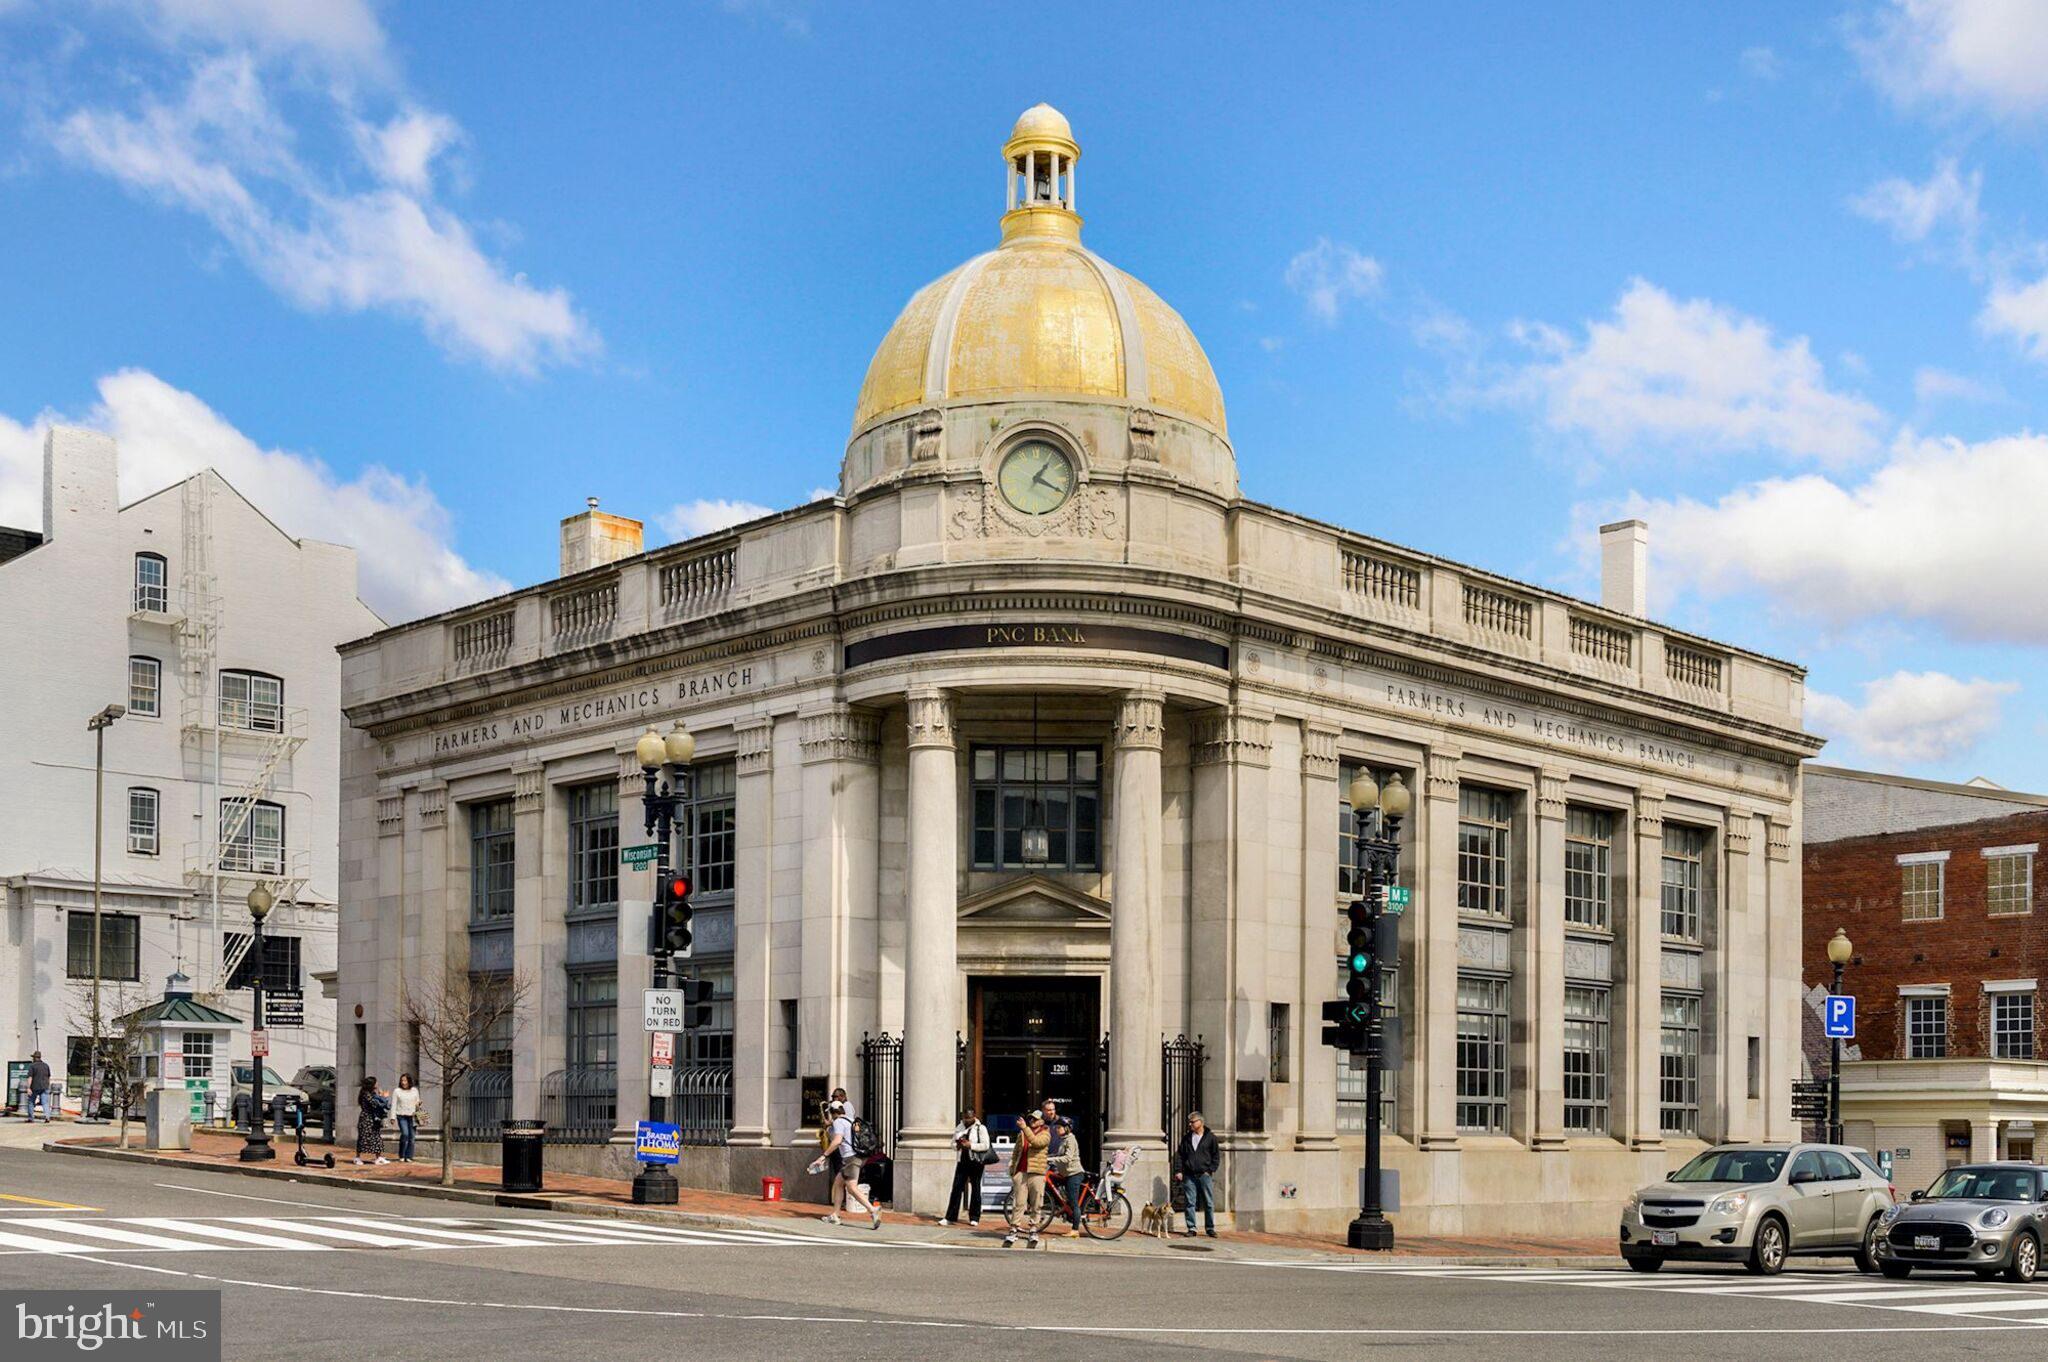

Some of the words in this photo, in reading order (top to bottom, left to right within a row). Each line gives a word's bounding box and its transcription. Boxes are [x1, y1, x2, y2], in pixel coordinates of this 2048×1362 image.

[987, 627, 1025, 643] PNC
[1034, 627, 1087, 643] BANK
[435, 723, 499, 753] FARMERS
[513, 716, 545, 736] AND
[560, 688, 660, 725] MECHANICS
[679, 668, 753, 699] BRANCH
[1387, 685, 1466, 718] FARMERS
[1482, 707, 1517, 729] AND
[1533, 718, 1625, 753] MECHANICS
[1639, 743, 1695, 769] BRANCH
[1391, 889, 1401, 901] M
[1387, 902, 1404, 911] 3100
[656, 996, 671, 1005] NO
[651, 1007, 677, 1015] TURN
[1833, 1000, 1847, 1022] P
[647, 1018, 659, 1026] ON
[663, 1018, 681, 1027] RED
[638, 1136, 680, 1149] THOMAS
